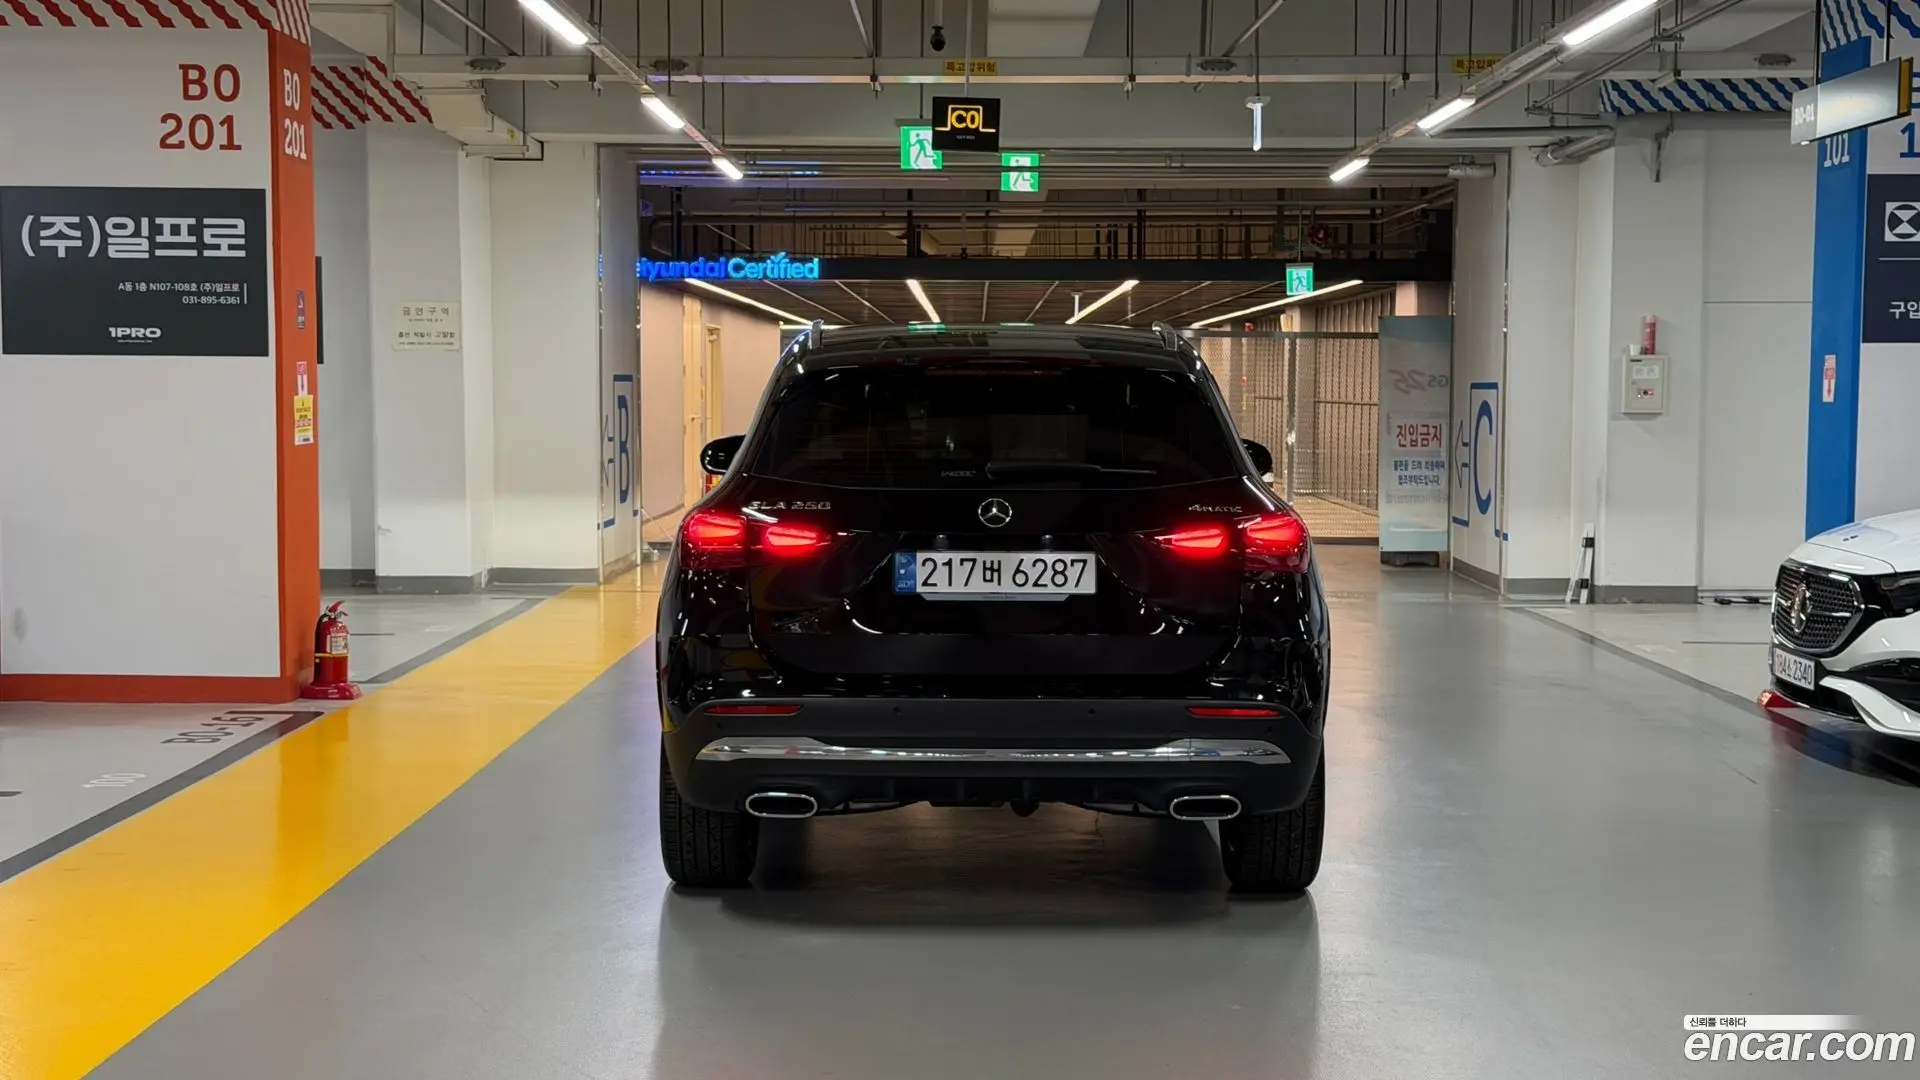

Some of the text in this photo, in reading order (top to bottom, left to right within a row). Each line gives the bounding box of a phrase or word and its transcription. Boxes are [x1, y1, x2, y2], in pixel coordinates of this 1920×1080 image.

[159, 113, 242, 150] 201
[284, 118, 307, 160] 201
[1824, 133, 1850, 168] 101
[21, 214, 247, 259] (주)일프로
[727, 251, 819, 278] Certified
[118, 282, 133, 292] A동
[182, 296, 240, 305] 031-895-6361
[109, 327, 162, 338] 1PRO
[1396, 423, 1443, 449] 진입금지
[1474, 400, 1493, 515] C
[791, 501, 831, 510] 250
[921, 557, 1088, 588] 217버 6287
[1793, 659, 1813, 685] 2340
